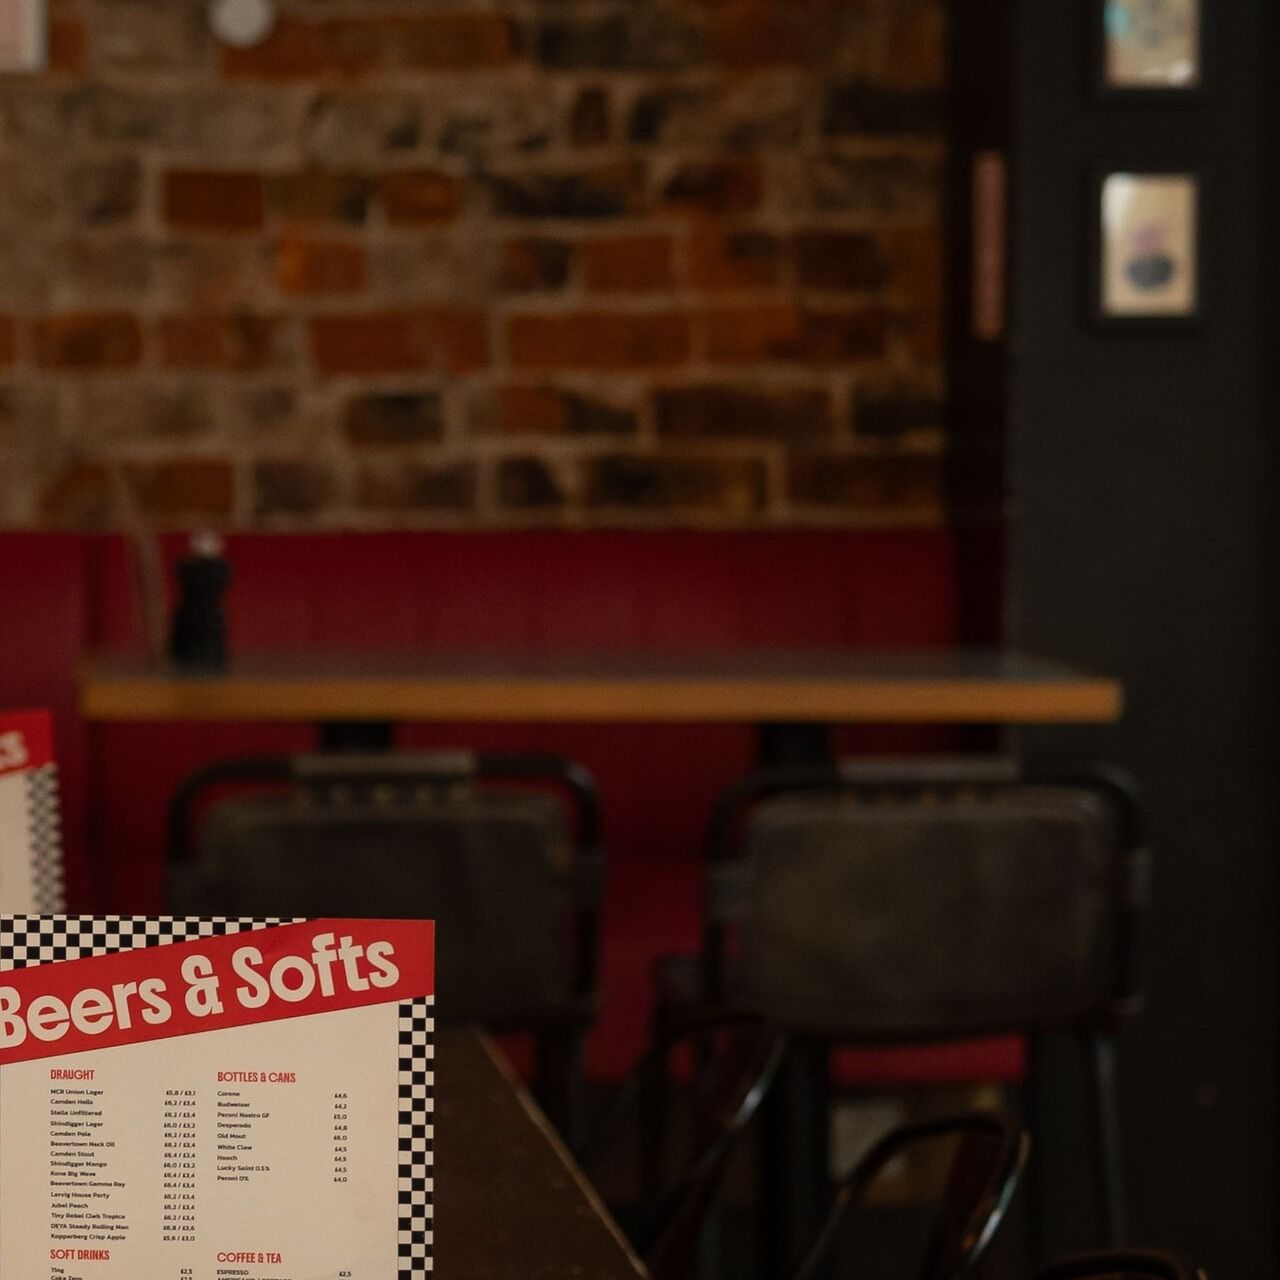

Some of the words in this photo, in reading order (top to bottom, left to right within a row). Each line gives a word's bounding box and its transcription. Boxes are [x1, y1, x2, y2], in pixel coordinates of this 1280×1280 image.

[181, 955, 224, 1016] &
[232, 933, 399, 1008] Softs
[51, 1069, 94, 1080] DRAUGHT
[218, 1072, 258, 1082] BOTTLES
[260, 1072, 266, 1082] &
[268, 1073, 295, 1083] CANS
[50, 1249, 75, 1259] SOFT
[78, 1250, 109, 1260] DRINKS
[217, 1252, 255, 1263] COFFEE
[258, 1253, 263, 1263] &
[266, 1253, 281, 1263] TEA
